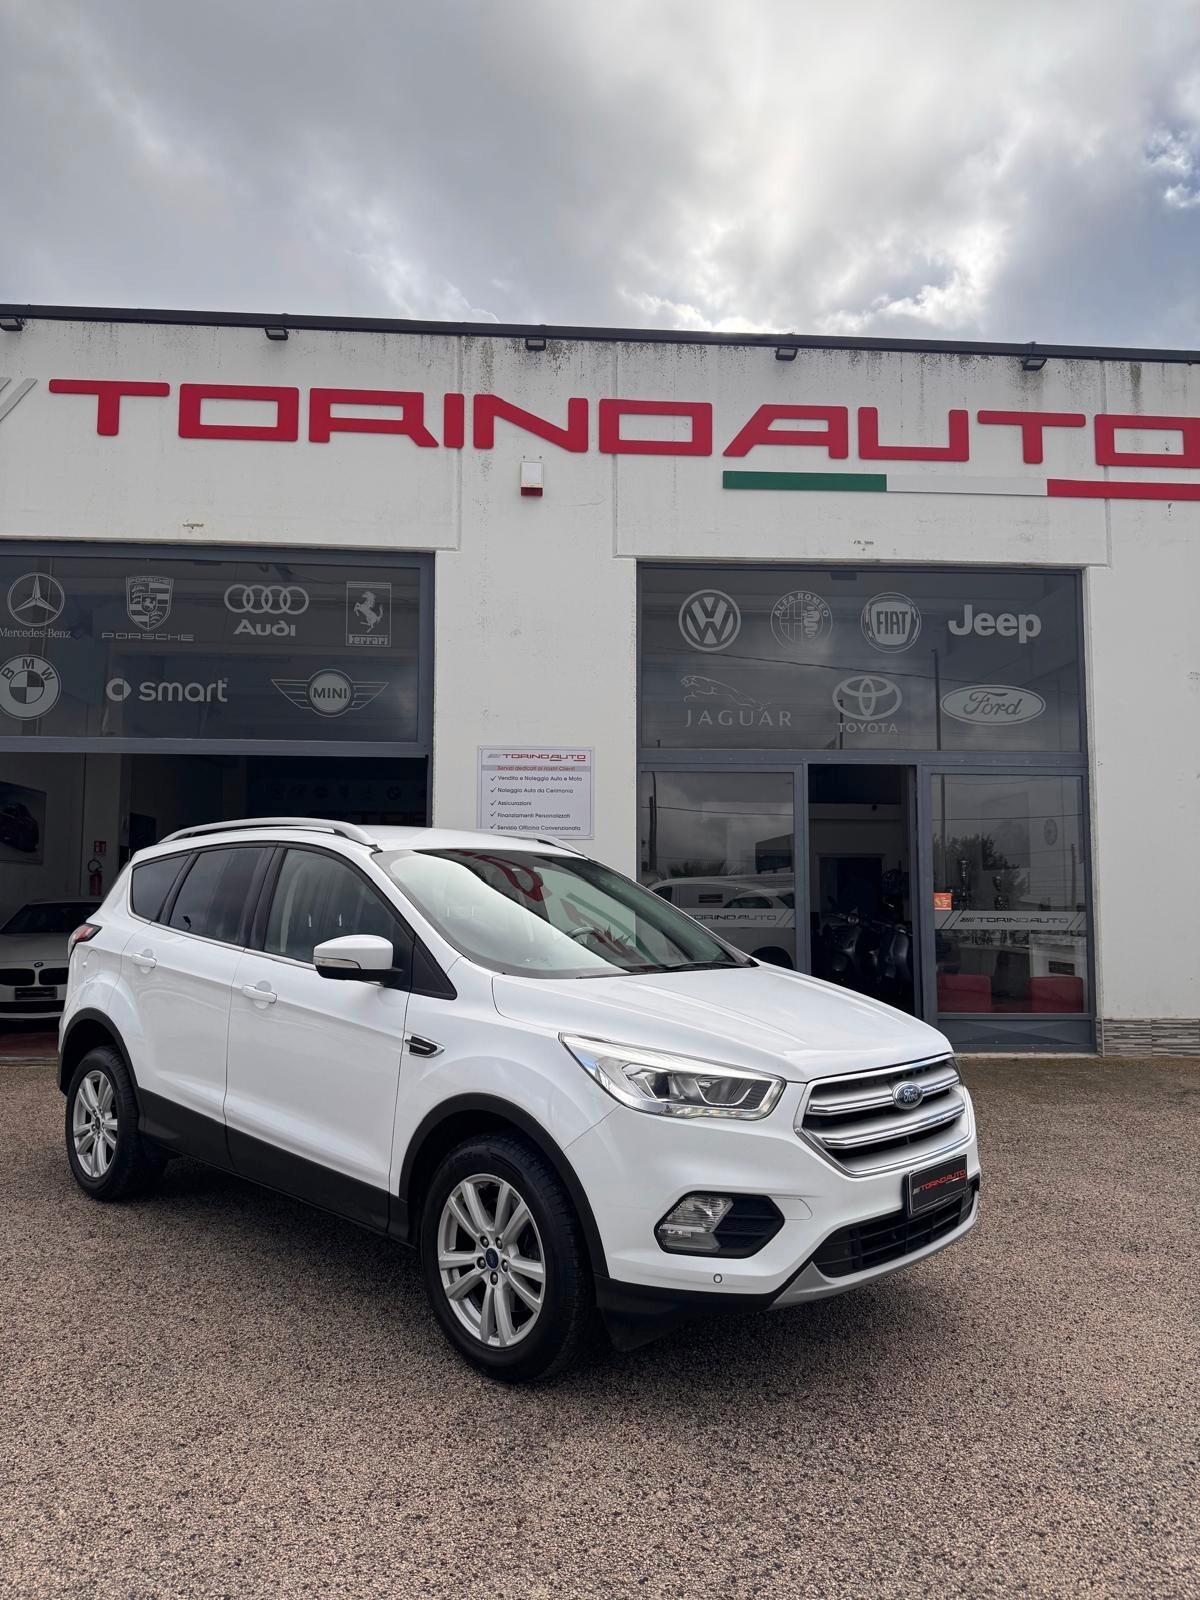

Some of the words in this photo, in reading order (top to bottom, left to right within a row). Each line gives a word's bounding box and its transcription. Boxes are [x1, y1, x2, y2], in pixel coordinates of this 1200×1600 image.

[49, 378, 1200, 468] TORINOAUTO
[774, 595, 795, 617] ALFA
[798, 593, 830, 618] ROMEO
[233, 619, 297, 637] Audi
[876, 610, 909, 635] FIAT
[948, 604, 1042, 644] Jeep
[0, 628, 72, 639] Mercedes-Benz
[101, 632, 195, 642] PORSCHE
[348, 634, 389, 646] Ferrari
[1, 658, 56, 682] BMW
[139, 679, 228, 702] smart
[313, 687, 348, 699] MINI
[963, 690, 1023, 716] Ford
[685, 709, 792, 728] JAGUAR
[837, 722, 898, 733] TOYOTA
